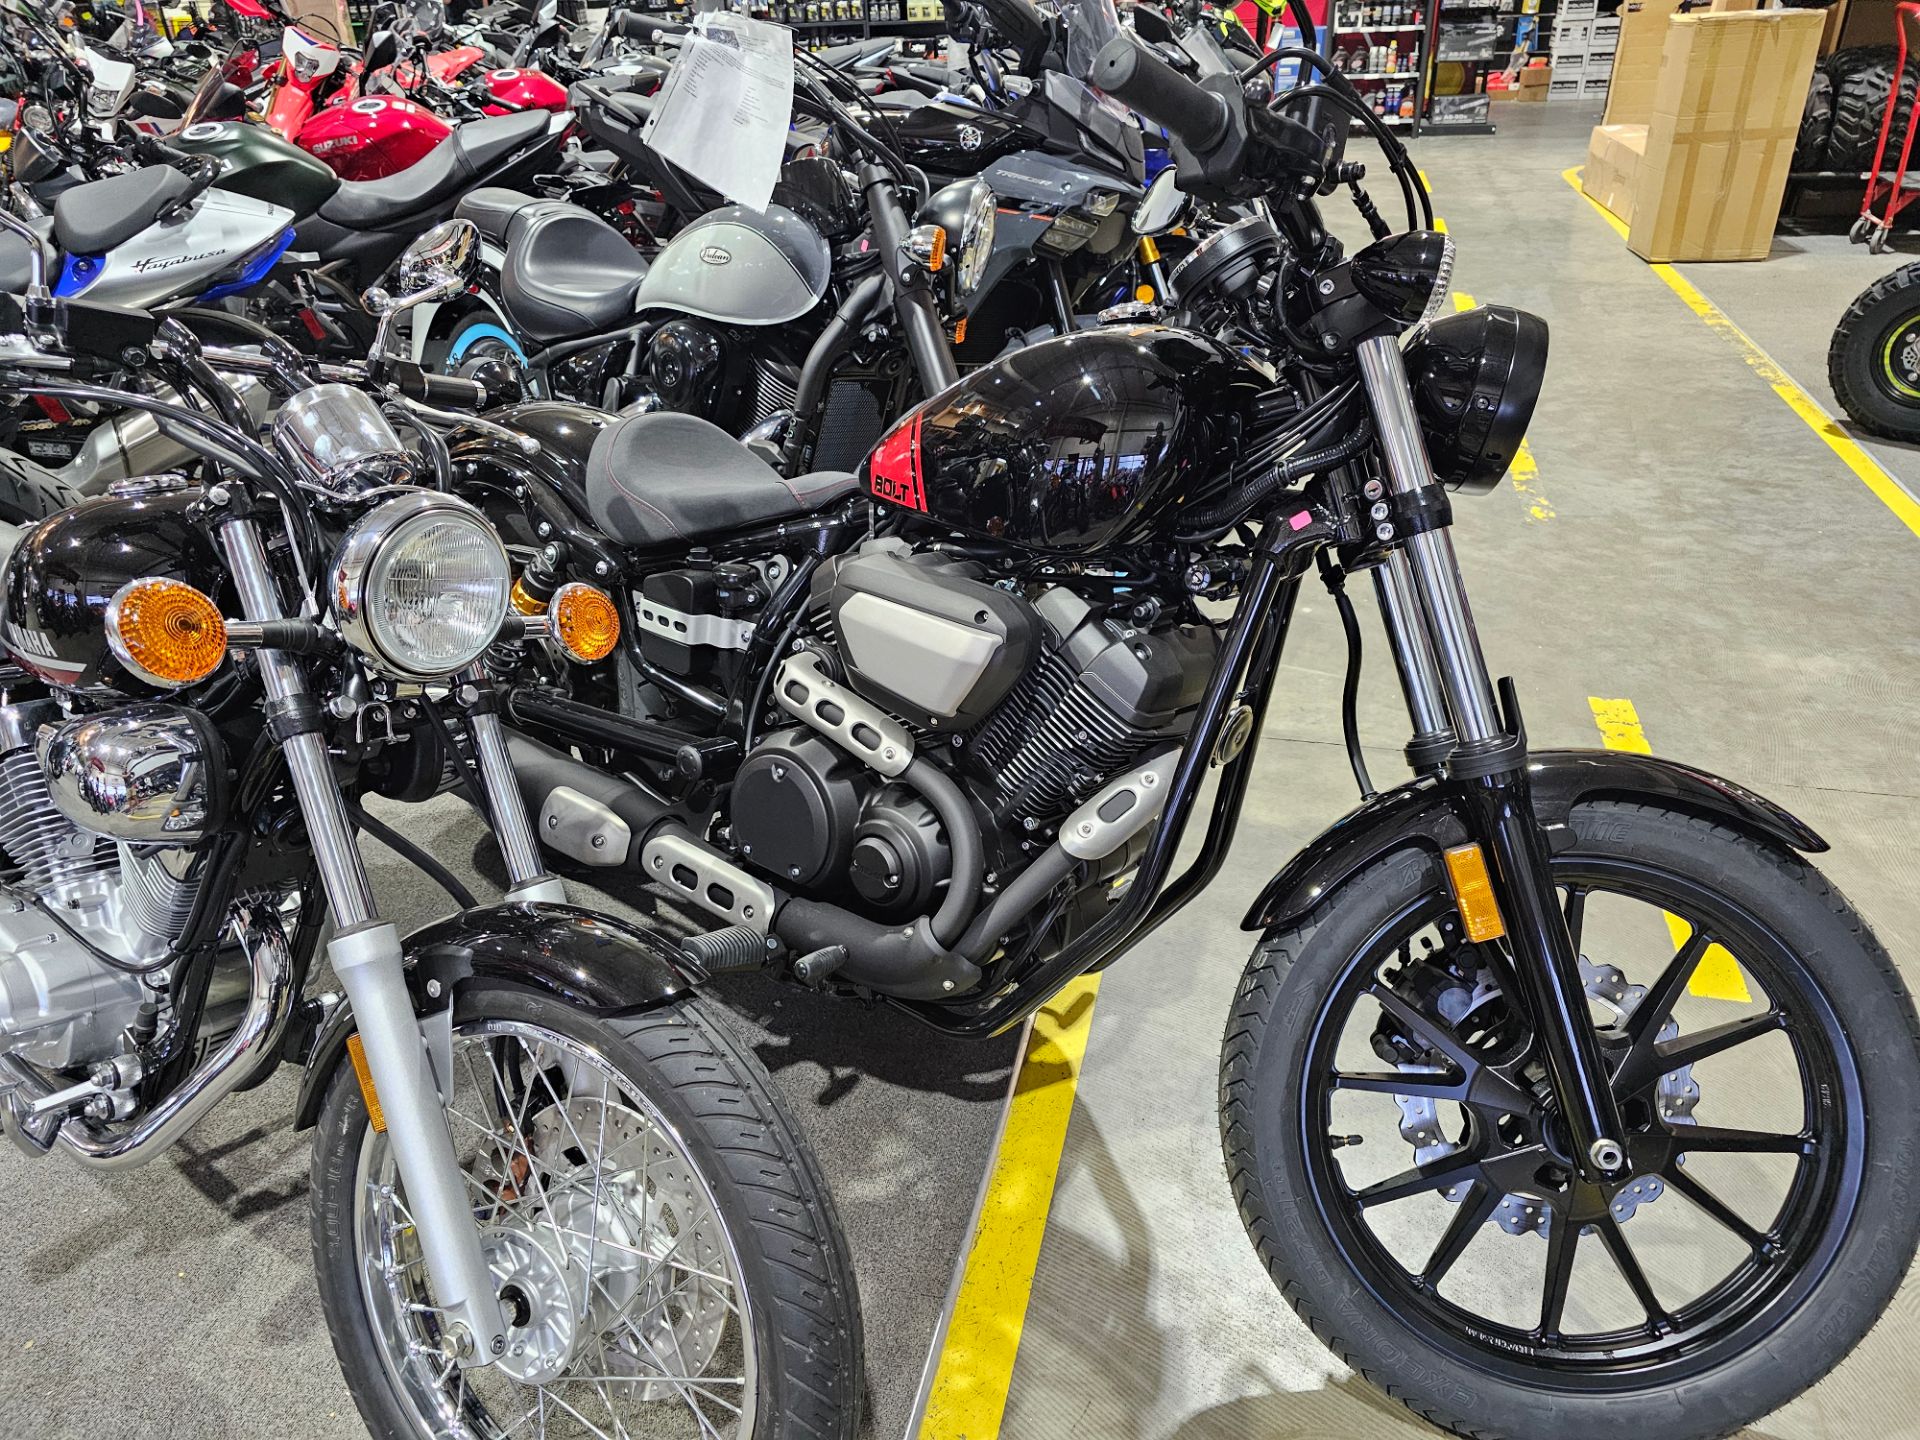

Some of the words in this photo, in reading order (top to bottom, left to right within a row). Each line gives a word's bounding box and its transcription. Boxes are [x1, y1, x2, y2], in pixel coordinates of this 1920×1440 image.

[312, 135, 358, 154] SUZUKI
[130, 248, 228, 273] Hayabusa
[702, 248, 729, 261] Vulcan
[875, 474, 910, 502] BOLT
[1336, 1295, 1479, 1410] EXEDRA
